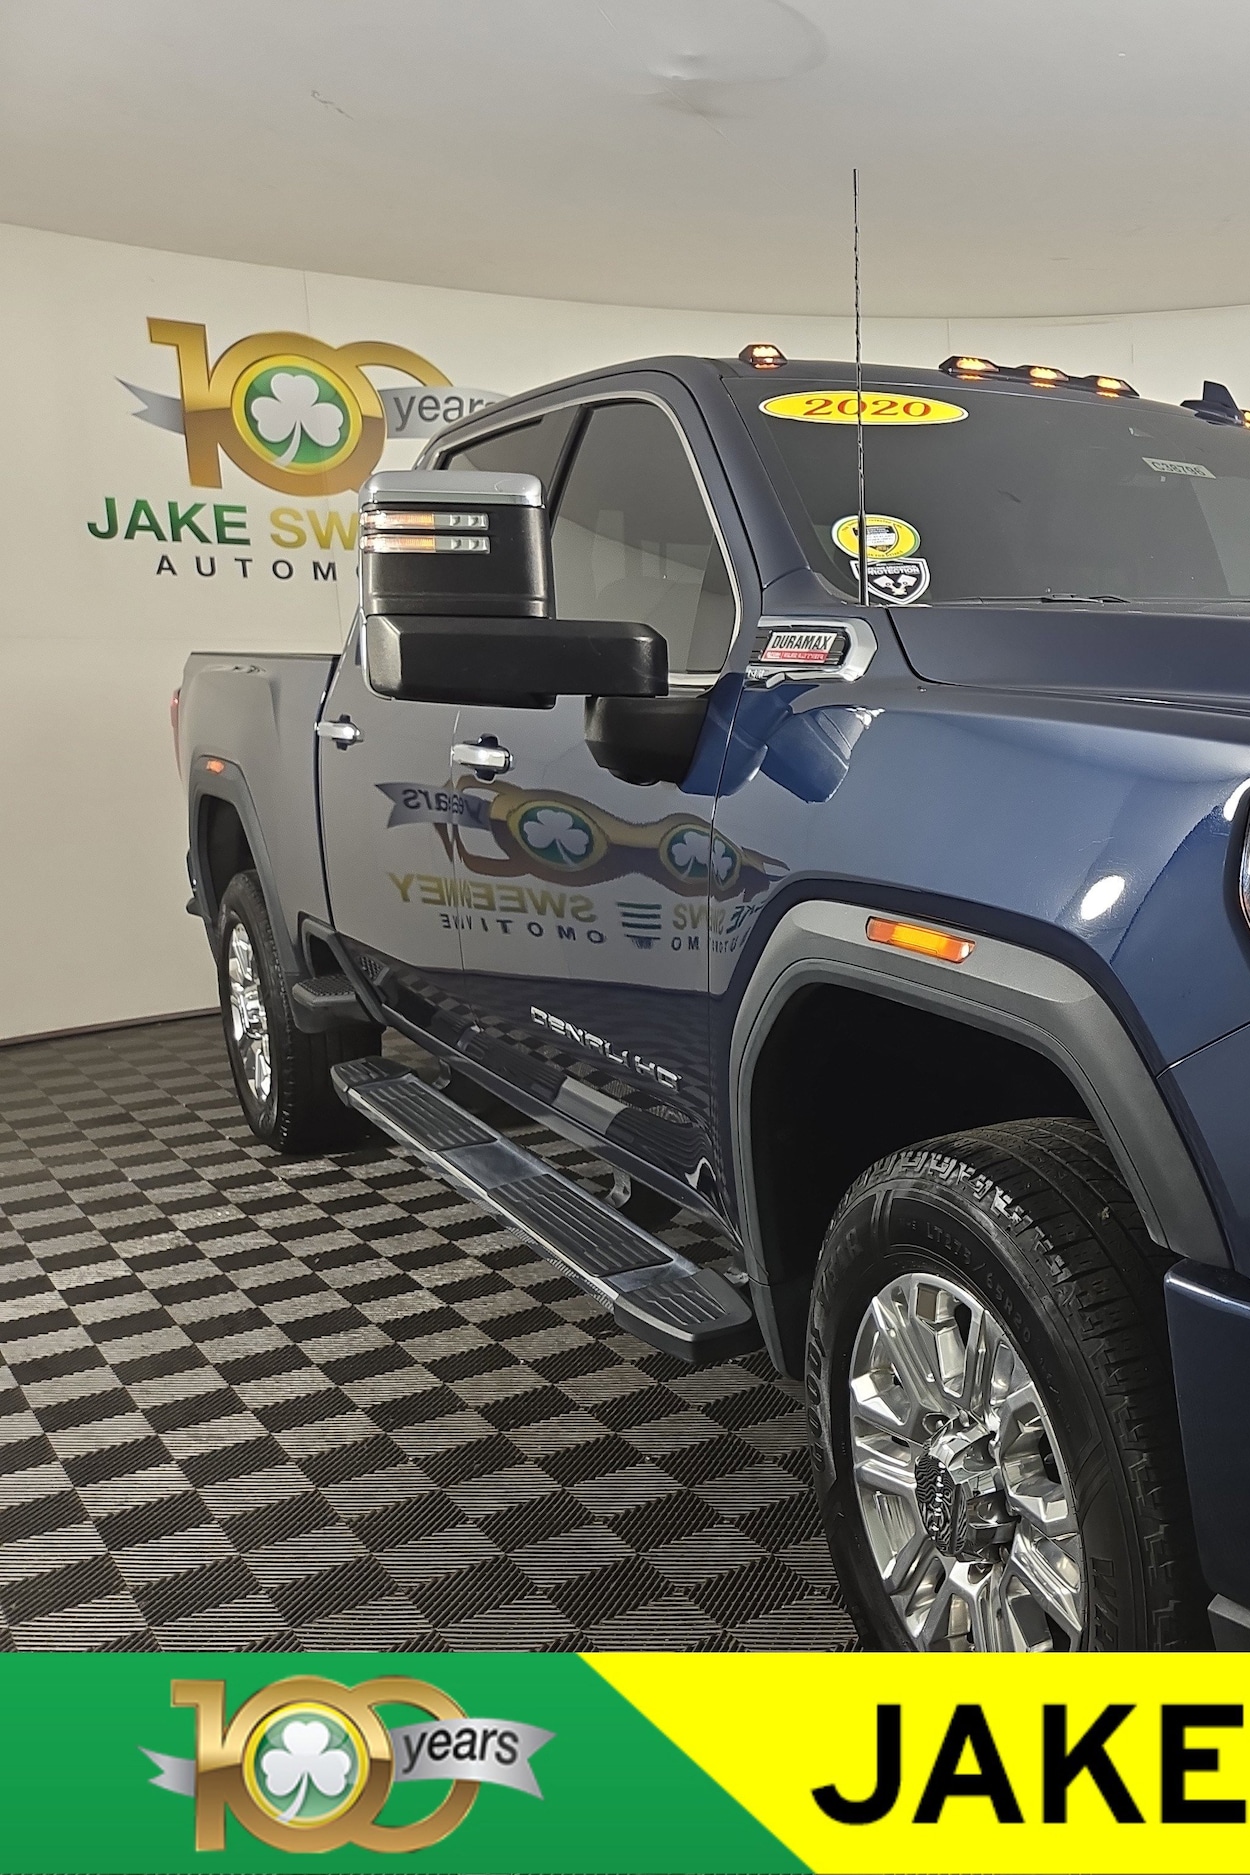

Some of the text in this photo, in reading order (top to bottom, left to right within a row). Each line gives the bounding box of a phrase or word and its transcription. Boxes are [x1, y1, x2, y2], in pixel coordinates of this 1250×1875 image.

[393, 394, 495, 432] year
[803, 398, 931, 417] 2020
[86, 496, 251, 546] JAKE
[771, 635, 832, 650] DURAMAX
[530, 1005, 682, 1094] DENALI HD
